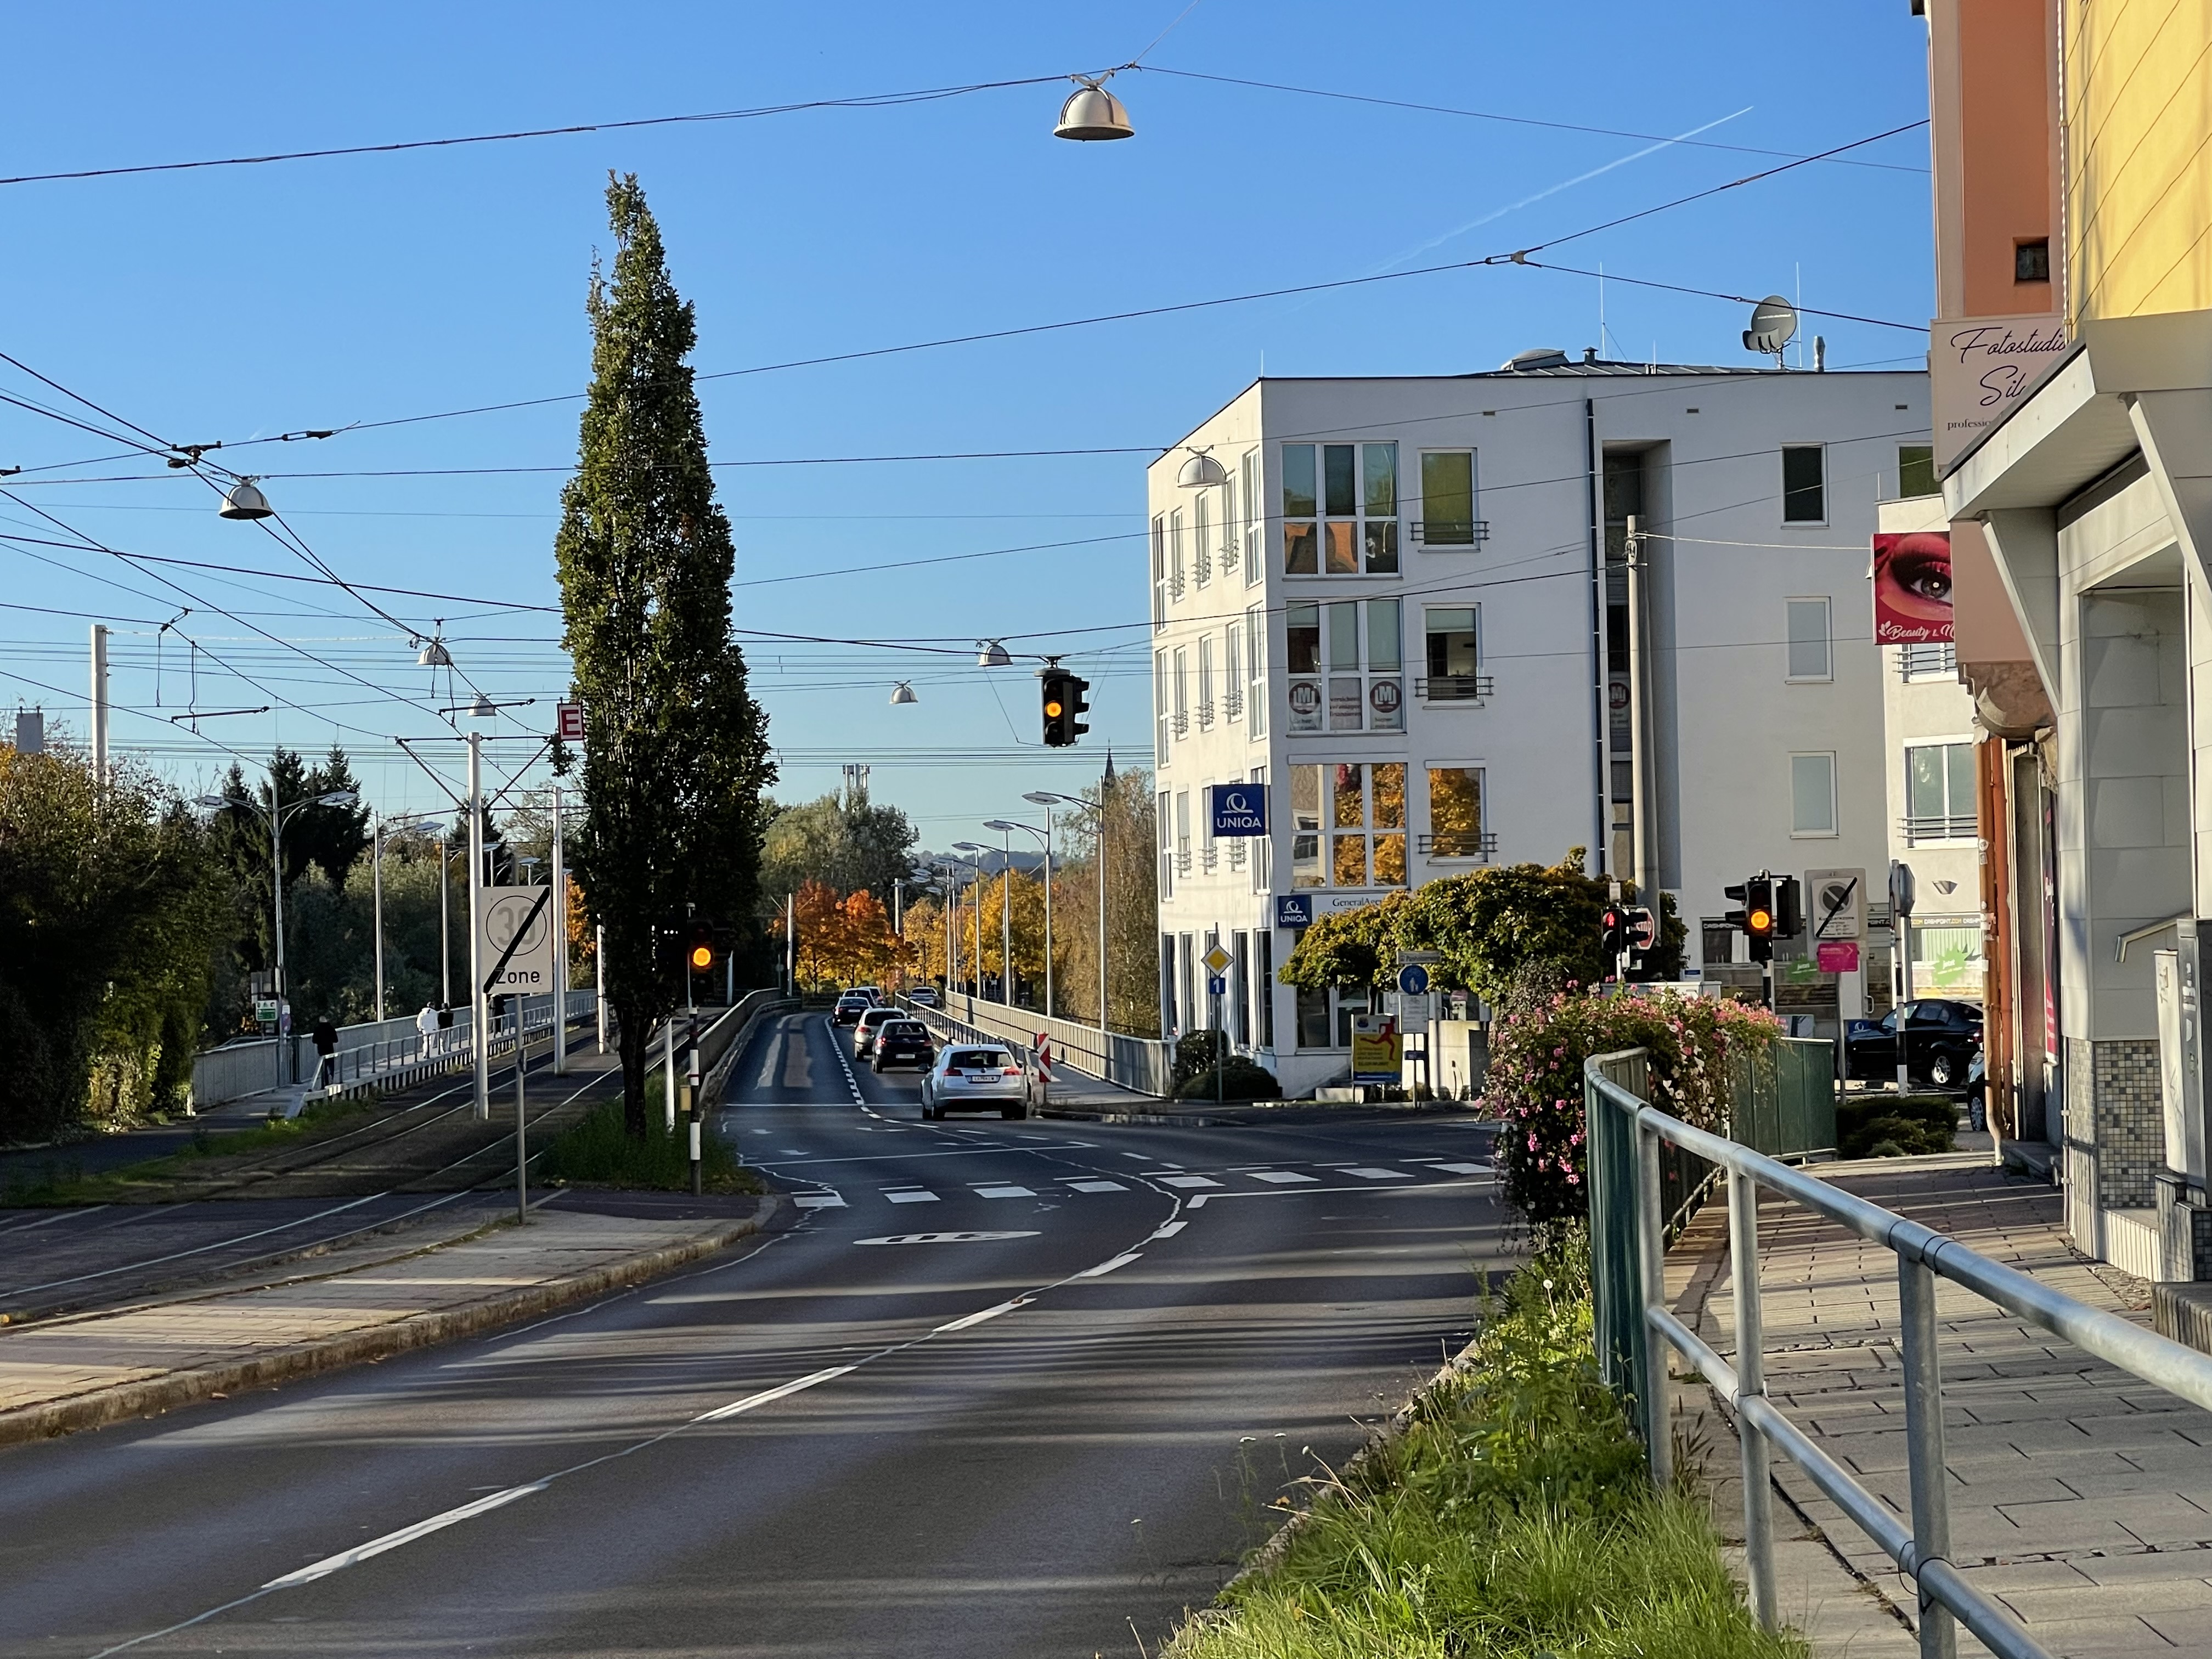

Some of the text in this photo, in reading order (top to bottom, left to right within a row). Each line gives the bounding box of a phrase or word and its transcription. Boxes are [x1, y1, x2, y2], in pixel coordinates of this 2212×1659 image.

[1950, 326, 2069, 364] Fotostudio
[1947, 417, 1991, 431] professio
[1886, 625, 1931, 641] Beauty
[1940, 623, 1954, 639] N
[561, 709, 580, 735] E
[1217, 817, 1262, 828] UNIQA
[497, 906, 535, 946] 30
[495, 967, 540, 984] Zone
[1214, 978, 1220, 993] 1
